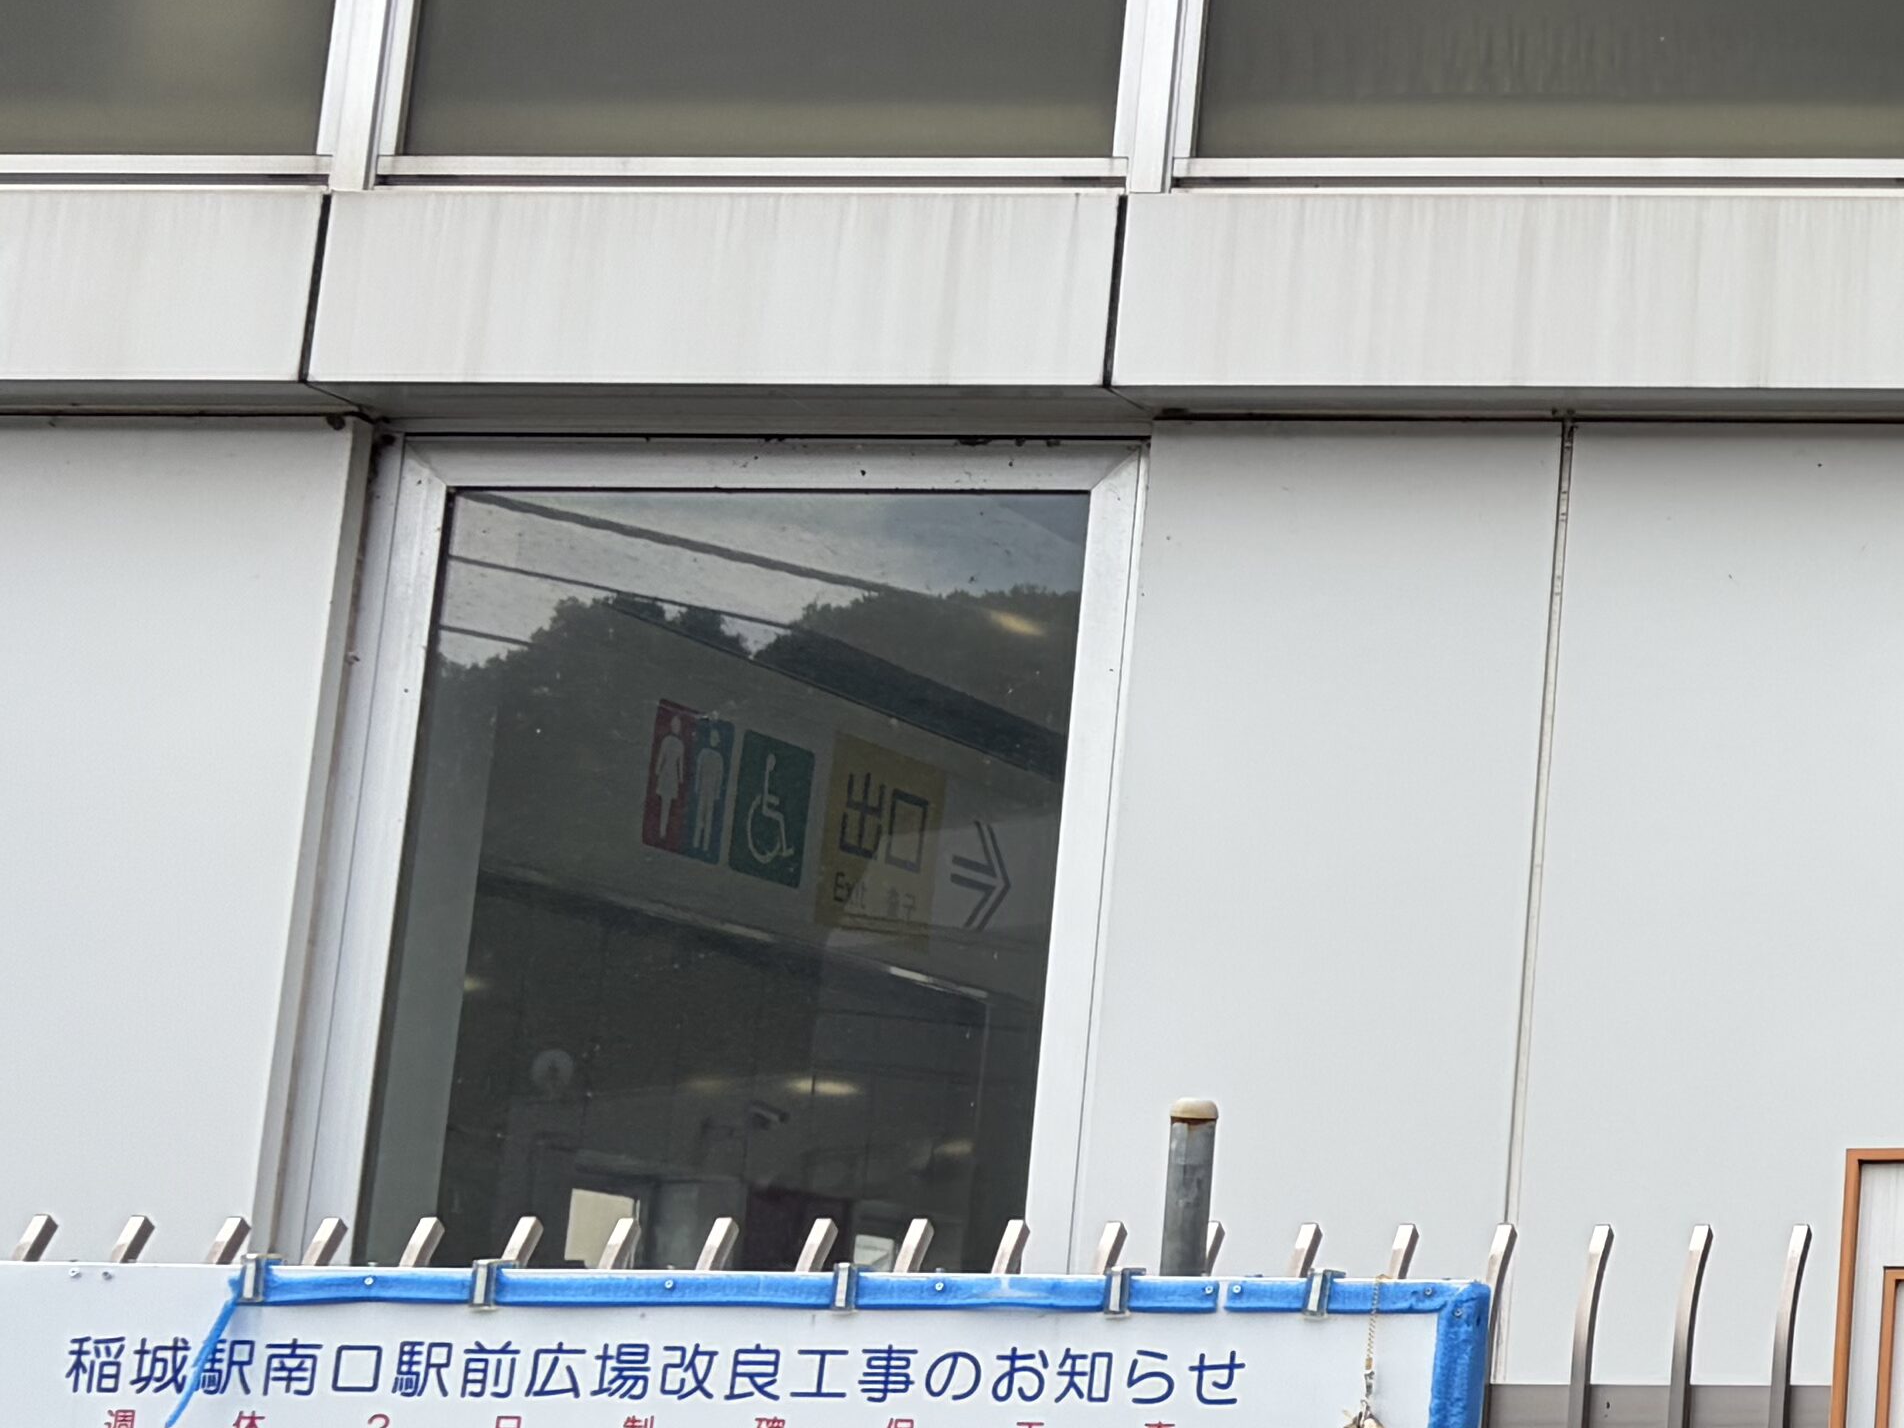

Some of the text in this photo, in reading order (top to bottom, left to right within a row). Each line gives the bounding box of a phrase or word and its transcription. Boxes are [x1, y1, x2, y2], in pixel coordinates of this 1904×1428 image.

[839, 771, 930, 875] 出口
[65, 1335, 1246, 1406] 稲城駅南口駅前広場改良工事のお知らせ
